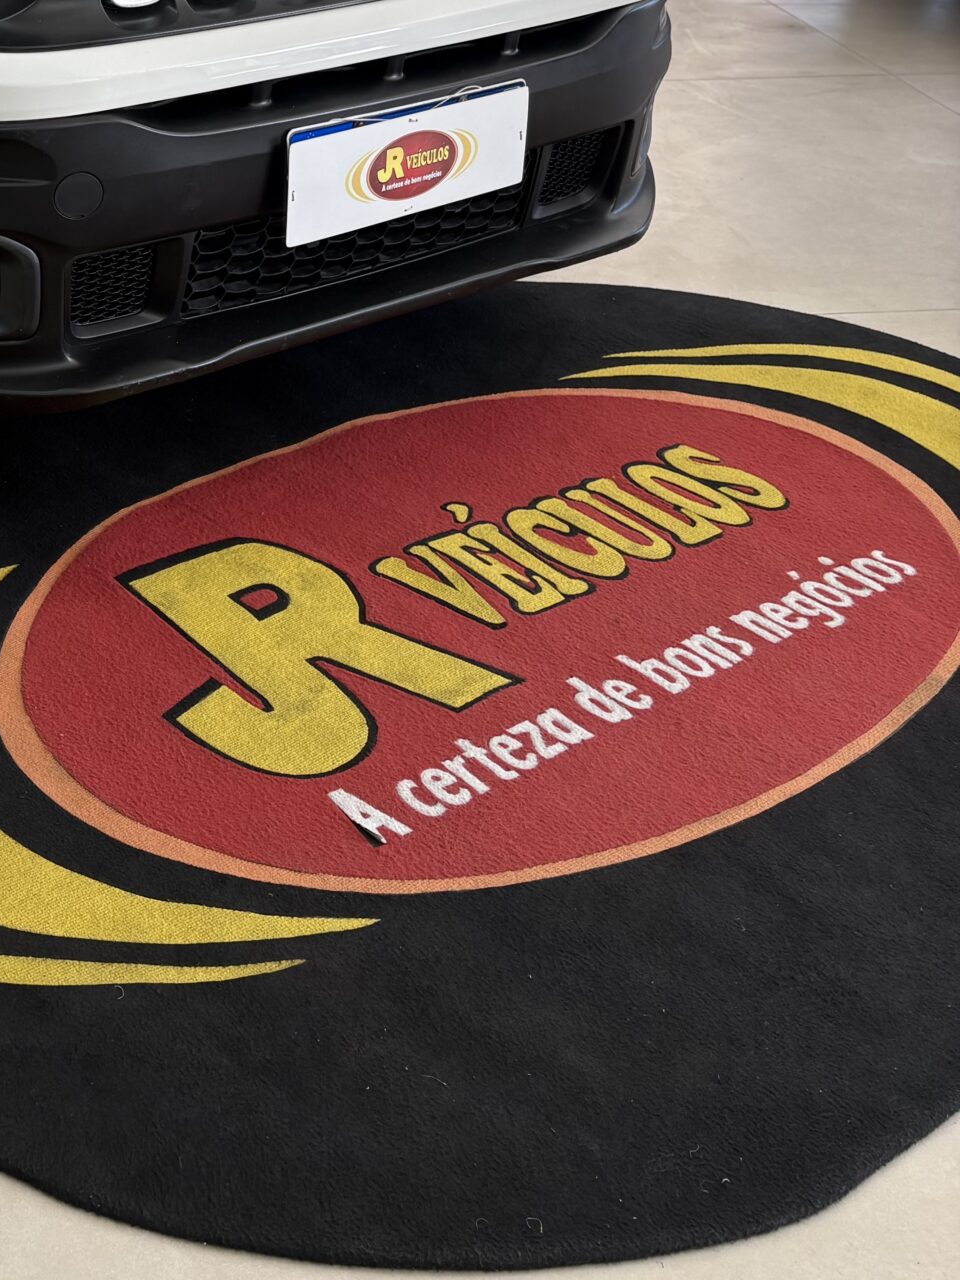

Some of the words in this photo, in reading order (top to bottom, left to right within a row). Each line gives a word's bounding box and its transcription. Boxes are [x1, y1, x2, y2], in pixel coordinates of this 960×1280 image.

[377, 146, 405, 183] JR
[406, 145, 450, 169] VEÍCULOS
[115, 538, 525, 780] JR
[368, 443, 791, 631] VEÍCULOS
[327, 788, 414, 846] A
[395, 707, 596, 818] certeza
[565, 675, 654, 724] de
[613, 624, 755, 695] bons
[729, 549, 918, 629] negócios
